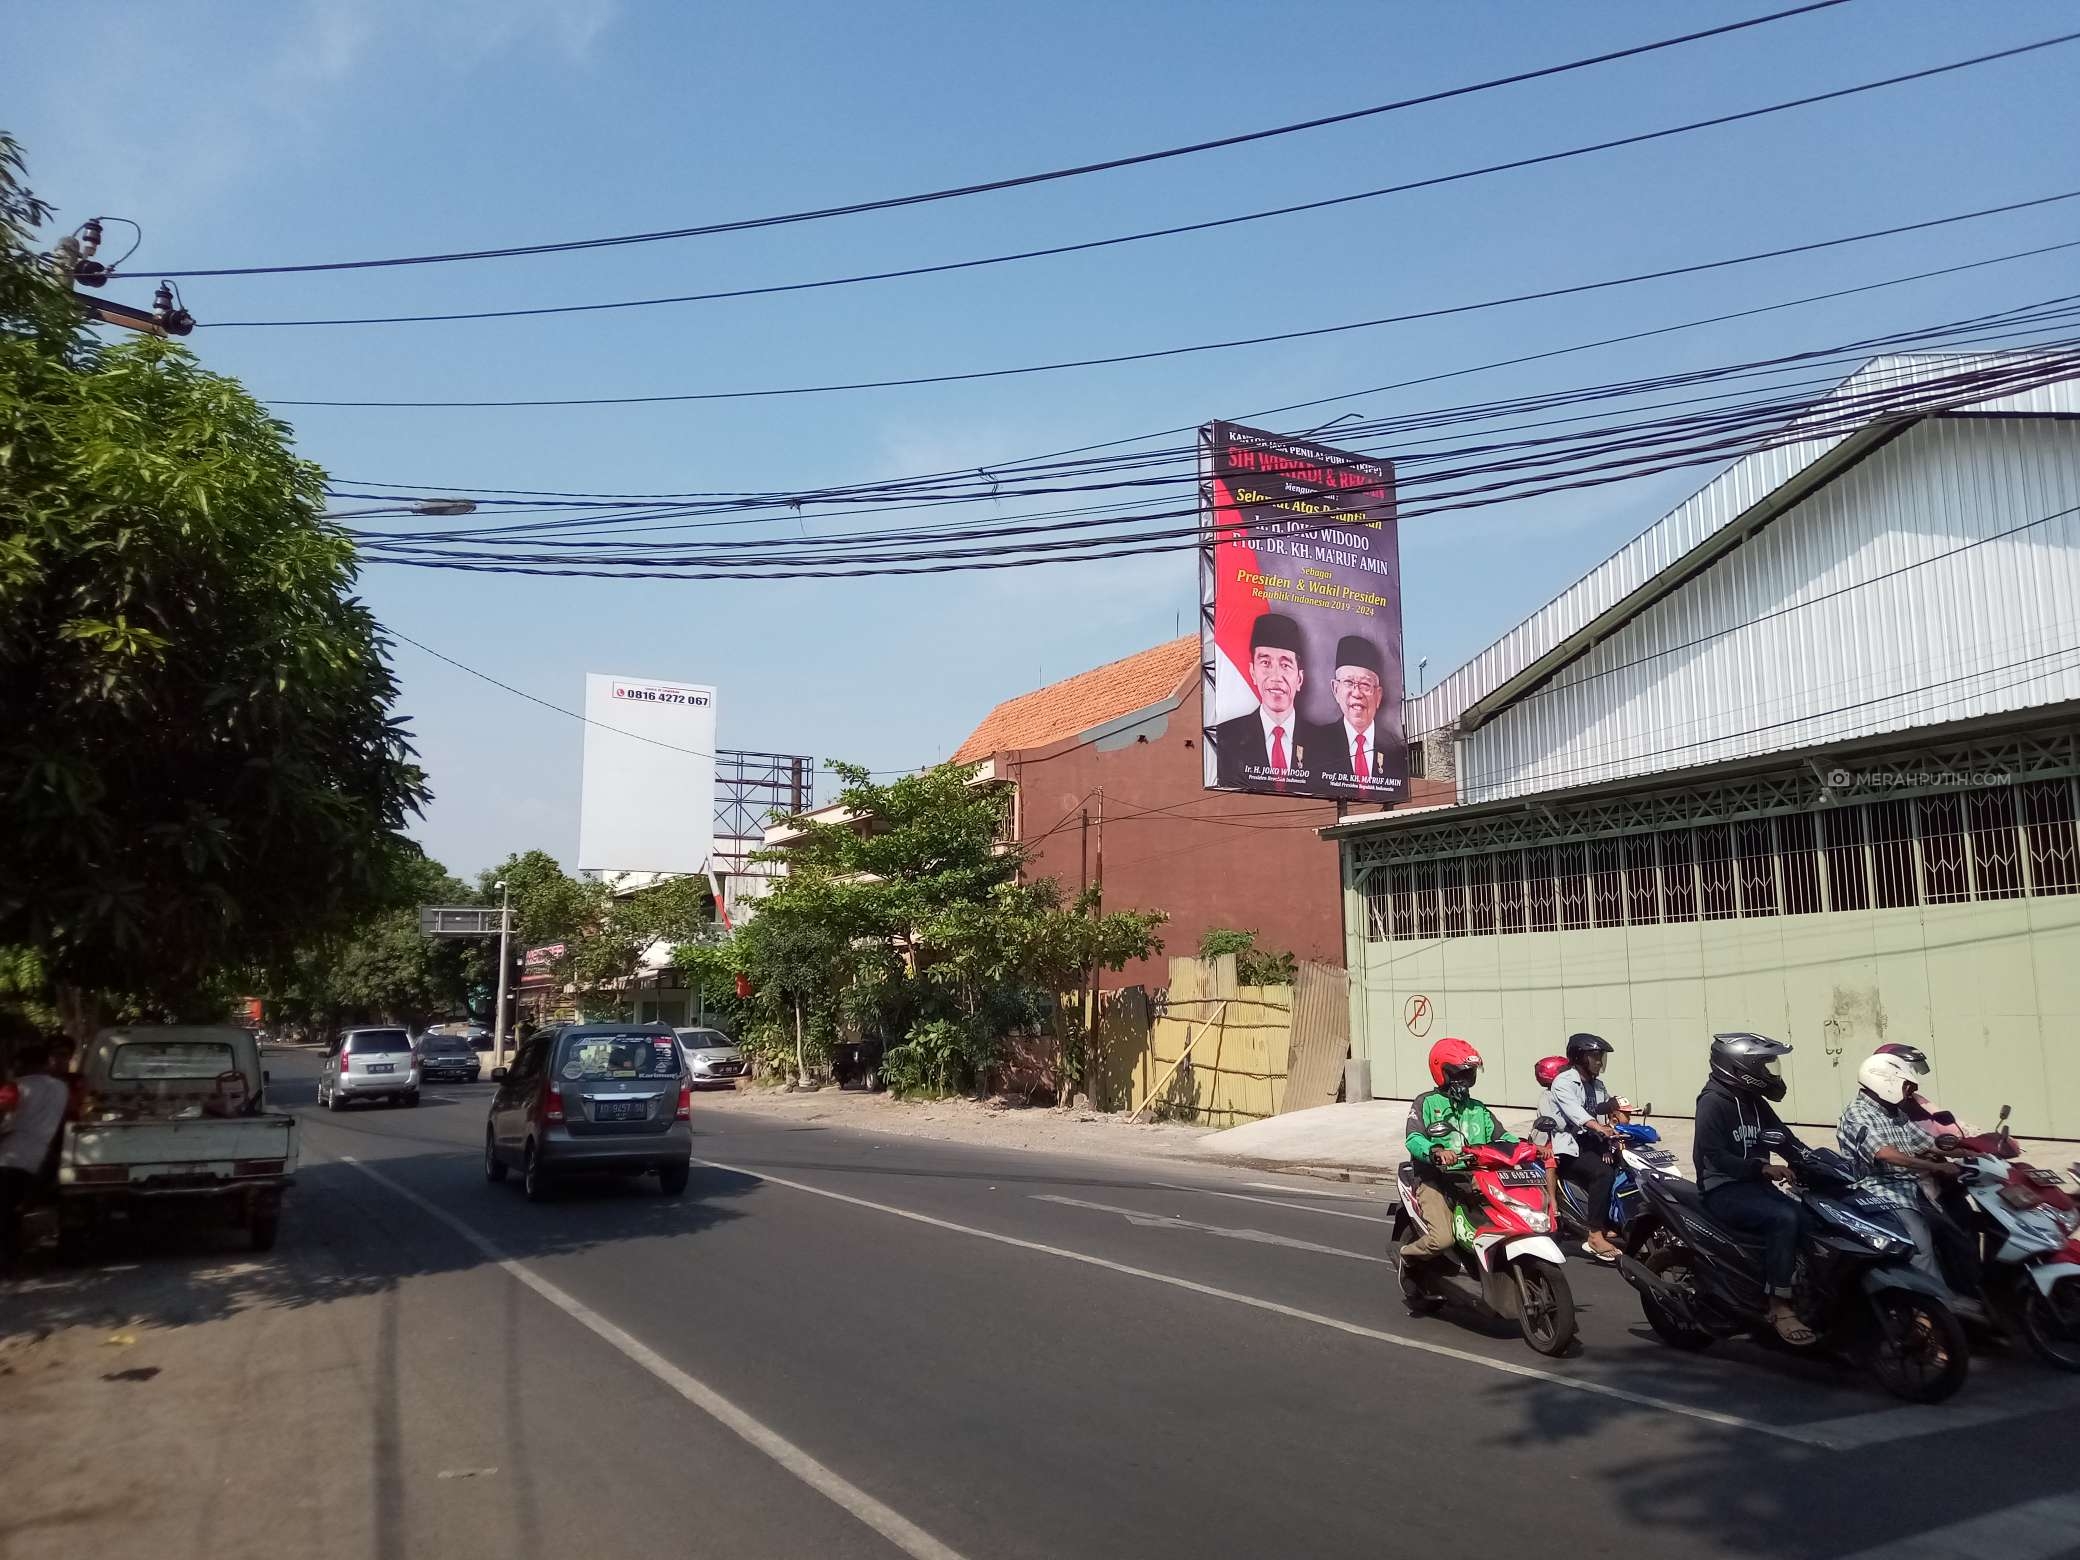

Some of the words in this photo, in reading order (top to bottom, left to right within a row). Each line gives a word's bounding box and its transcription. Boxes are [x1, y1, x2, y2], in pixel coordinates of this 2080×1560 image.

[1326, 467, 1337, 488] &
[1291, 500, 1321, 514] Atas
[1320, 528, 1370, 551] WIDODO
[1266, 537, 1288, 555] DR.
[1290, 541, 1313, 559] KH.
[1315, 545, 1358, 568] MA'RUF
[1359, 558, 1389, 576] AMIN
[1236, 569, 1291, 589] Presiden
[1296, 579, 1305, 592] &
[1308, 580, 1340, 598] Wakil
[1342, 586, 1388, 608] Presiden
[1251, 587, 1290, 602] Republik
[1290, 593, 1330, 608] Indonesia
[1331, 600, 1351, 612] 2019
[1356, 605, 1375, 617] 2024
[627, 689, 656, 701] 0816
[658, 693, 685, 704] 4272
[687, 696, 709, 706] 067
[1321, 771, 1337, 782] Prof.
[1337, 773, 1349, 781] DR.
[1384, 778, 1402, 787] AMIN
